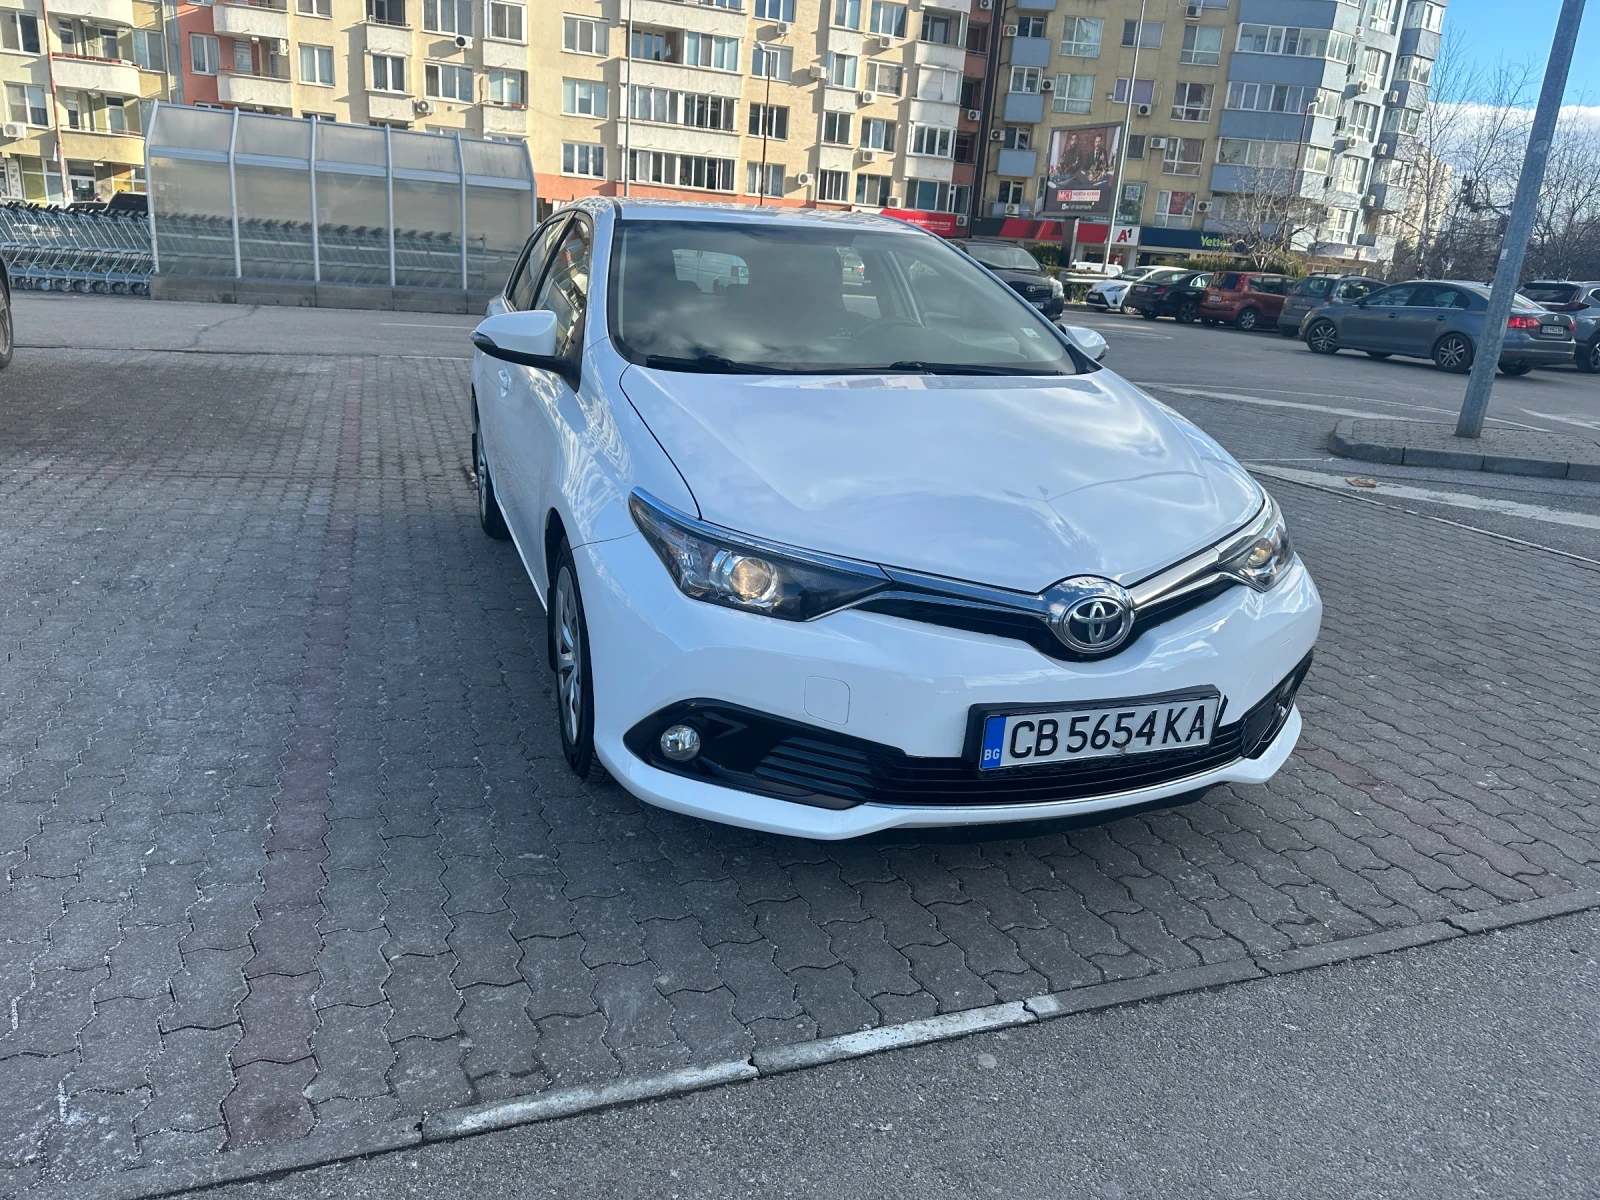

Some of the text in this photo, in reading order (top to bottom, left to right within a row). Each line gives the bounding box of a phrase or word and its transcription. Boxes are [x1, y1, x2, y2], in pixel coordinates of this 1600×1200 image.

[1116, 228, 1132, 243] A1
[1010, 704, 1205, 759] CB 5654 KA
[983, 748, 1000, 761] BG
